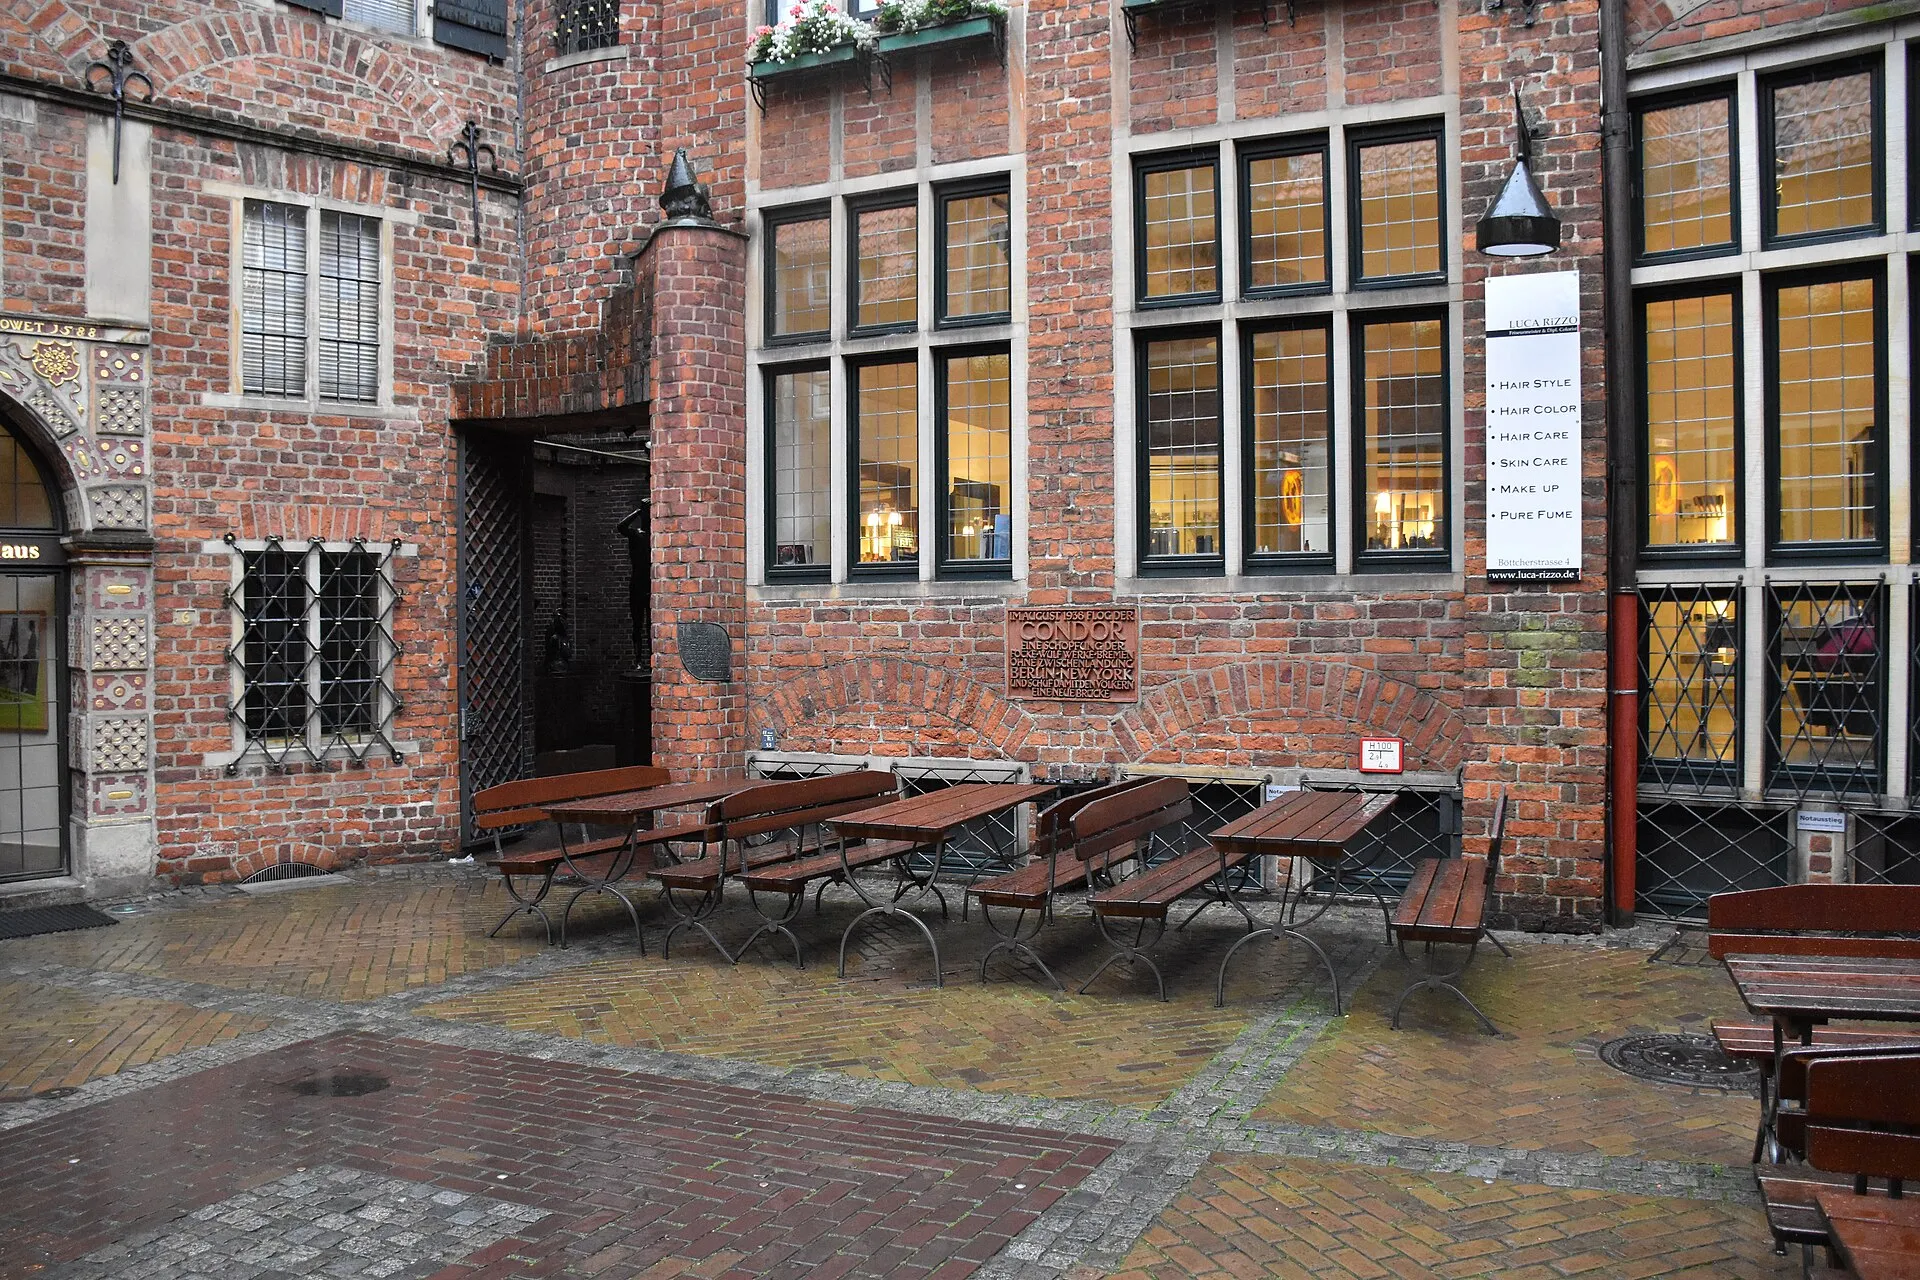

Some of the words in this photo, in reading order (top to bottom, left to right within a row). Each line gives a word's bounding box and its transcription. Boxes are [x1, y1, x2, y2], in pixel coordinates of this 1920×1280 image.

[1509, 319, 1540, 329] LUCA
[1500, 381, 1530, 390] HAIR
[1533, 379, 1571, 388] STYLE
[1500, 407, 1530, 415] HAIR
[1533, 405, 1577, 414] COLOR
[1500, 433, 1530, 441] HAIR
[1533, 431, 1569, 440] CARE
[1500, 458, 1529, 467] SKIN
[1533, 457, 1568, 466] CARE
[1500, 485, 1536, 493] MAKE
[1500, 511, 1534, 520] PURE
[1538, 510, 1573, 519] FUME
[1492, 570, 1575, 579] www.luca-rizzo.de
[1010, 611, 1021, 621] IM
[1022, 611, 1061, 621] AUGUST
[1086, 611, 1112, 621] FLOG
[1114, 611, 1135, 621] DER
[1020, 621, 1127, 641] CONDOR
[1021, 641, 1043, 650] EINE
[1105, 641, 1126, 651] DER
[1010, 658, 1038, 667] OHNE
[1039, 658, 1134, 669] ZWISCHENLANDUNG
[1092, 668, 1133, 681] YORK
[1011, 679, 1027, 688] UND
[1028, 679, 1054, 688] SCHUF
[1054, 680, 1080, 689] DAMIT
[1080, 680, 1095, 689] DEN
[1032, 688, 1052, 697] EINE
[1053, 688, 1076, 698] NEUE
[1800, 815, 1843, 825] Notausstieg
